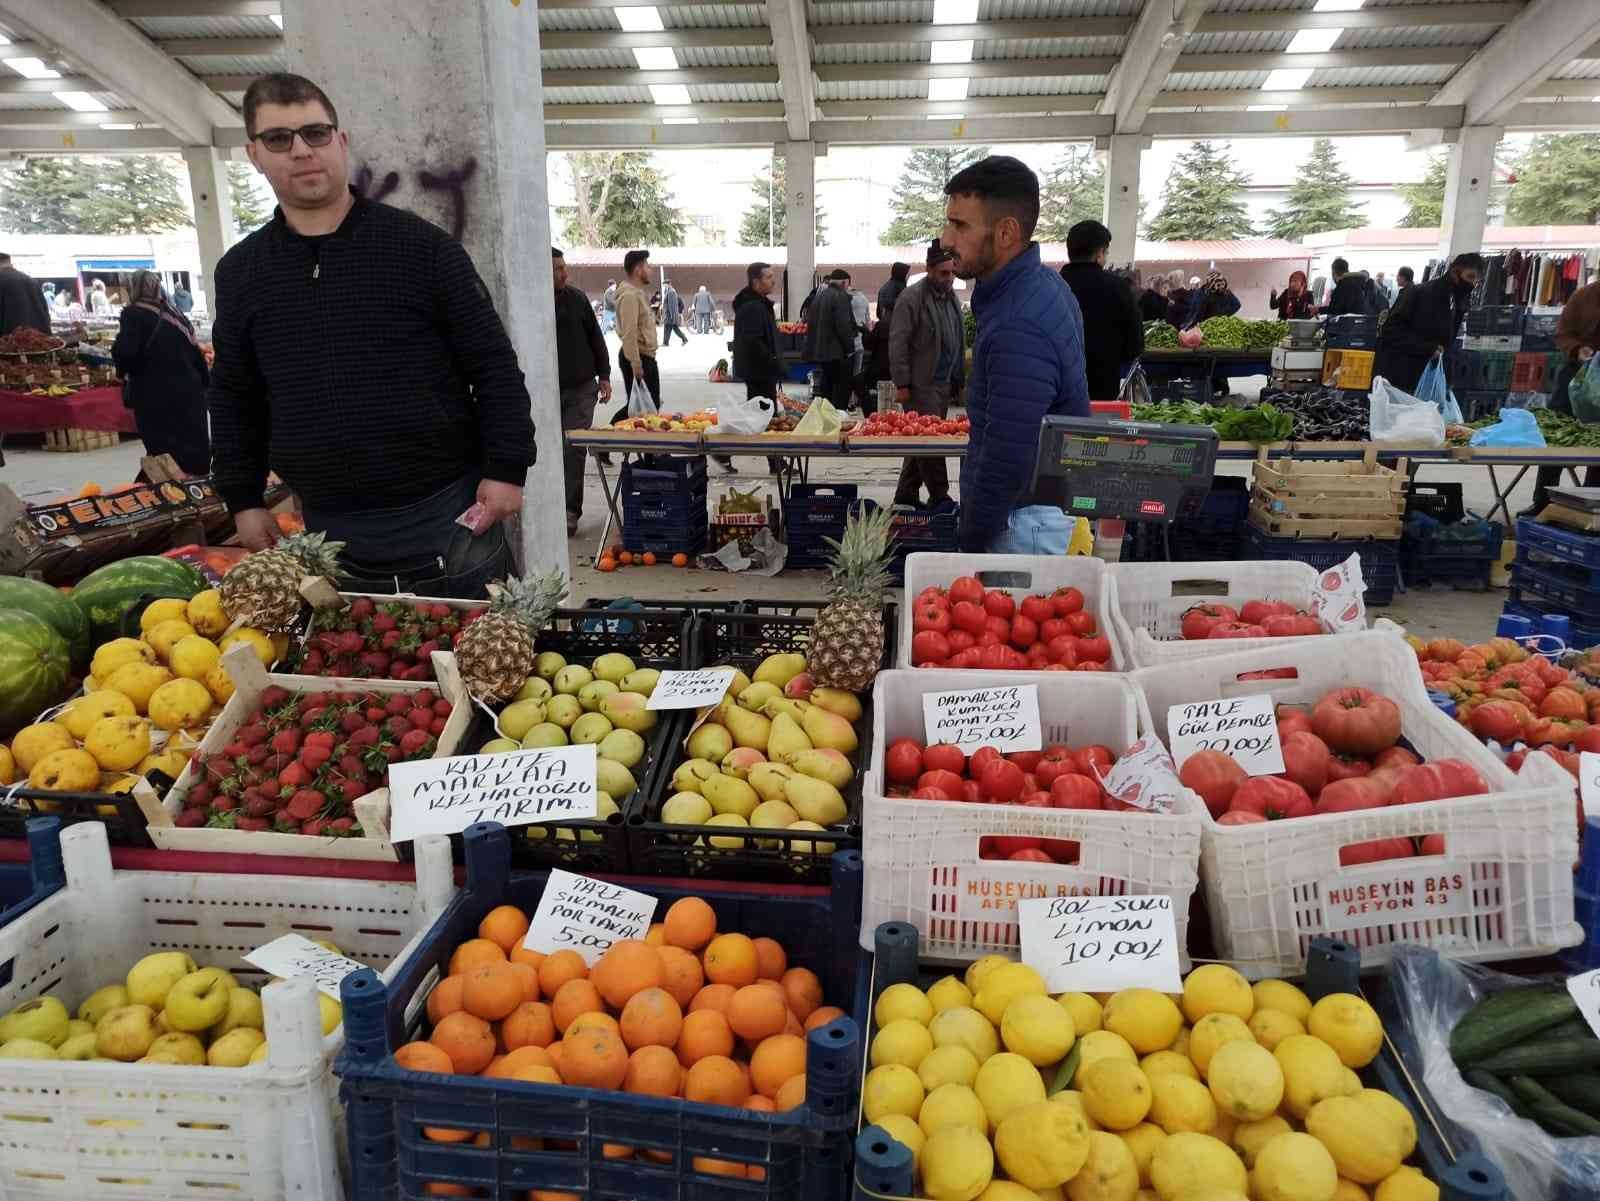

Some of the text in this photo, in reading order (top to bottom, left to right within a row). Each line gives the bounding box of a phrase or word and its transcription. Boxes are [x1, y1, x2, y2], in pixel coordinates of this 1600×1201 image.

[69, 490, 162, 524] EKER
[937, 712, 1019, 729] DOMATES
[1183, 700, 1245, 719] TAZE
[1178, 714, 1273, 736] GÜL PEMBE
[572, 878, 628, 900] TAZE
[981, 899, 1017, 910] AFY
[1345, 893, 1449, 916] AFYON 43
